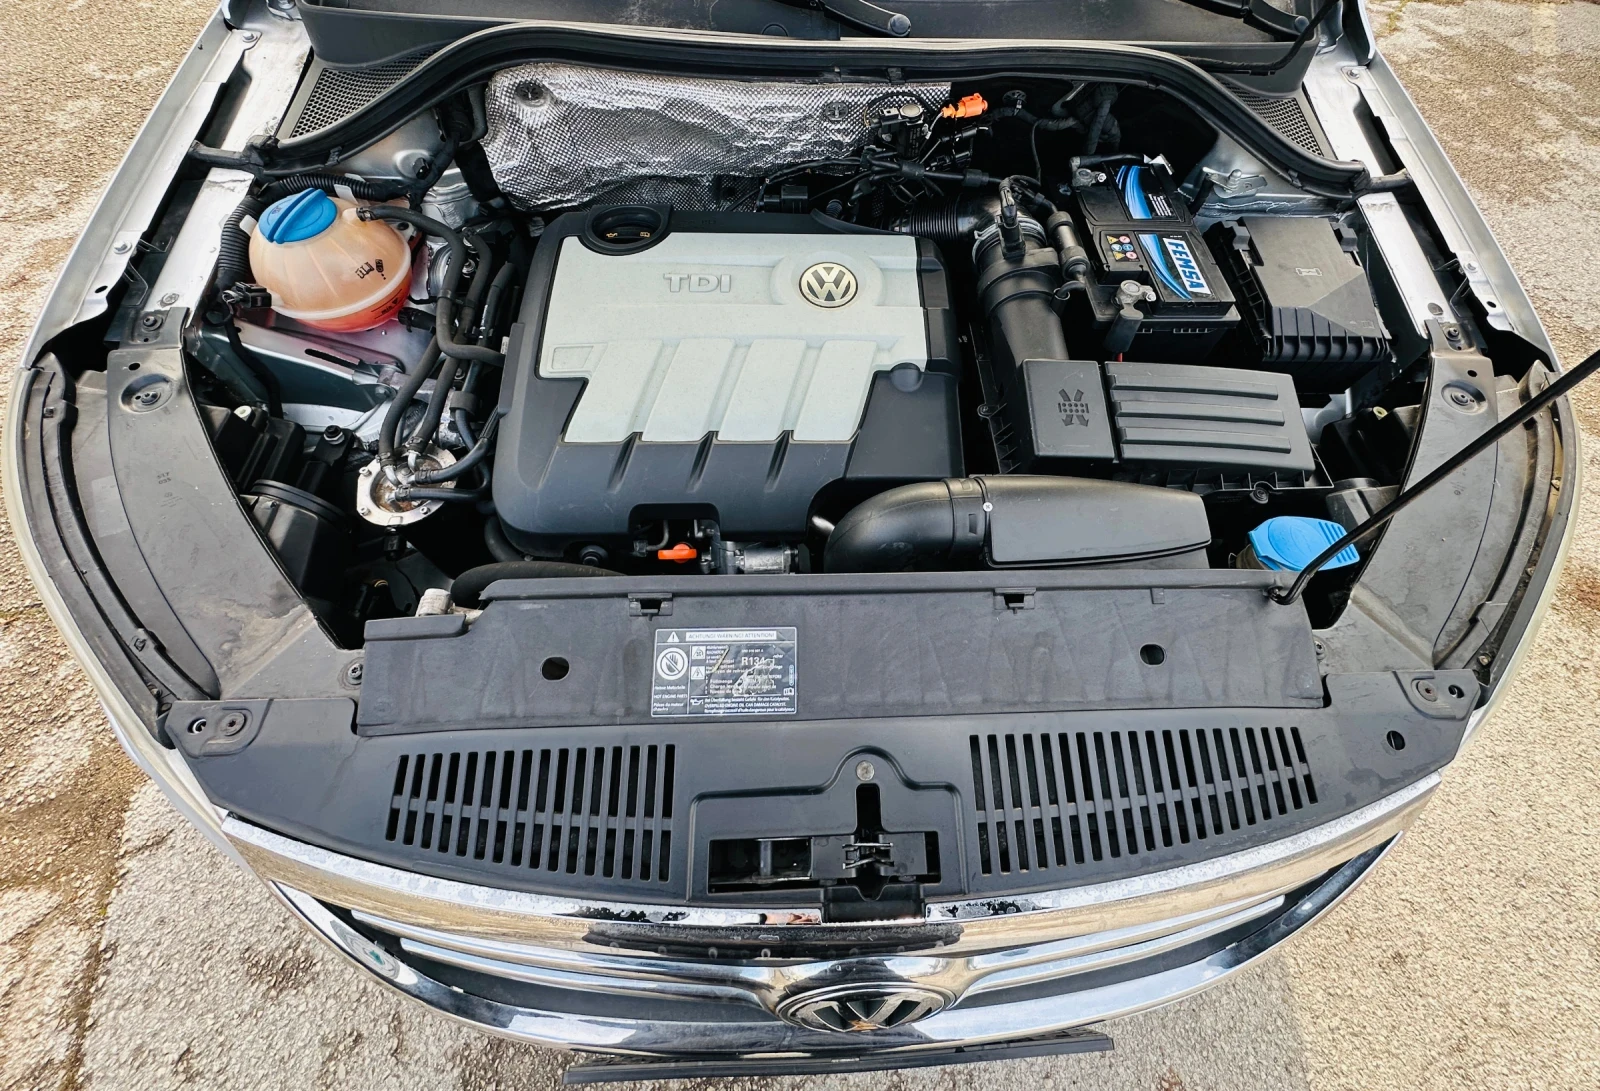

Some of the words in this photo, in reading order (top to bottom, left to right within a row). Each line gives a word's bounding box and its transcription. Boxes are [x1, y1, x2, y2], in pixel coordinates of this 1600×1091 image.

[663, 273, 731, 293] TDI
[801, 263, 856, 306] VW
[1167, 241, 1205, 290] FEMSA
